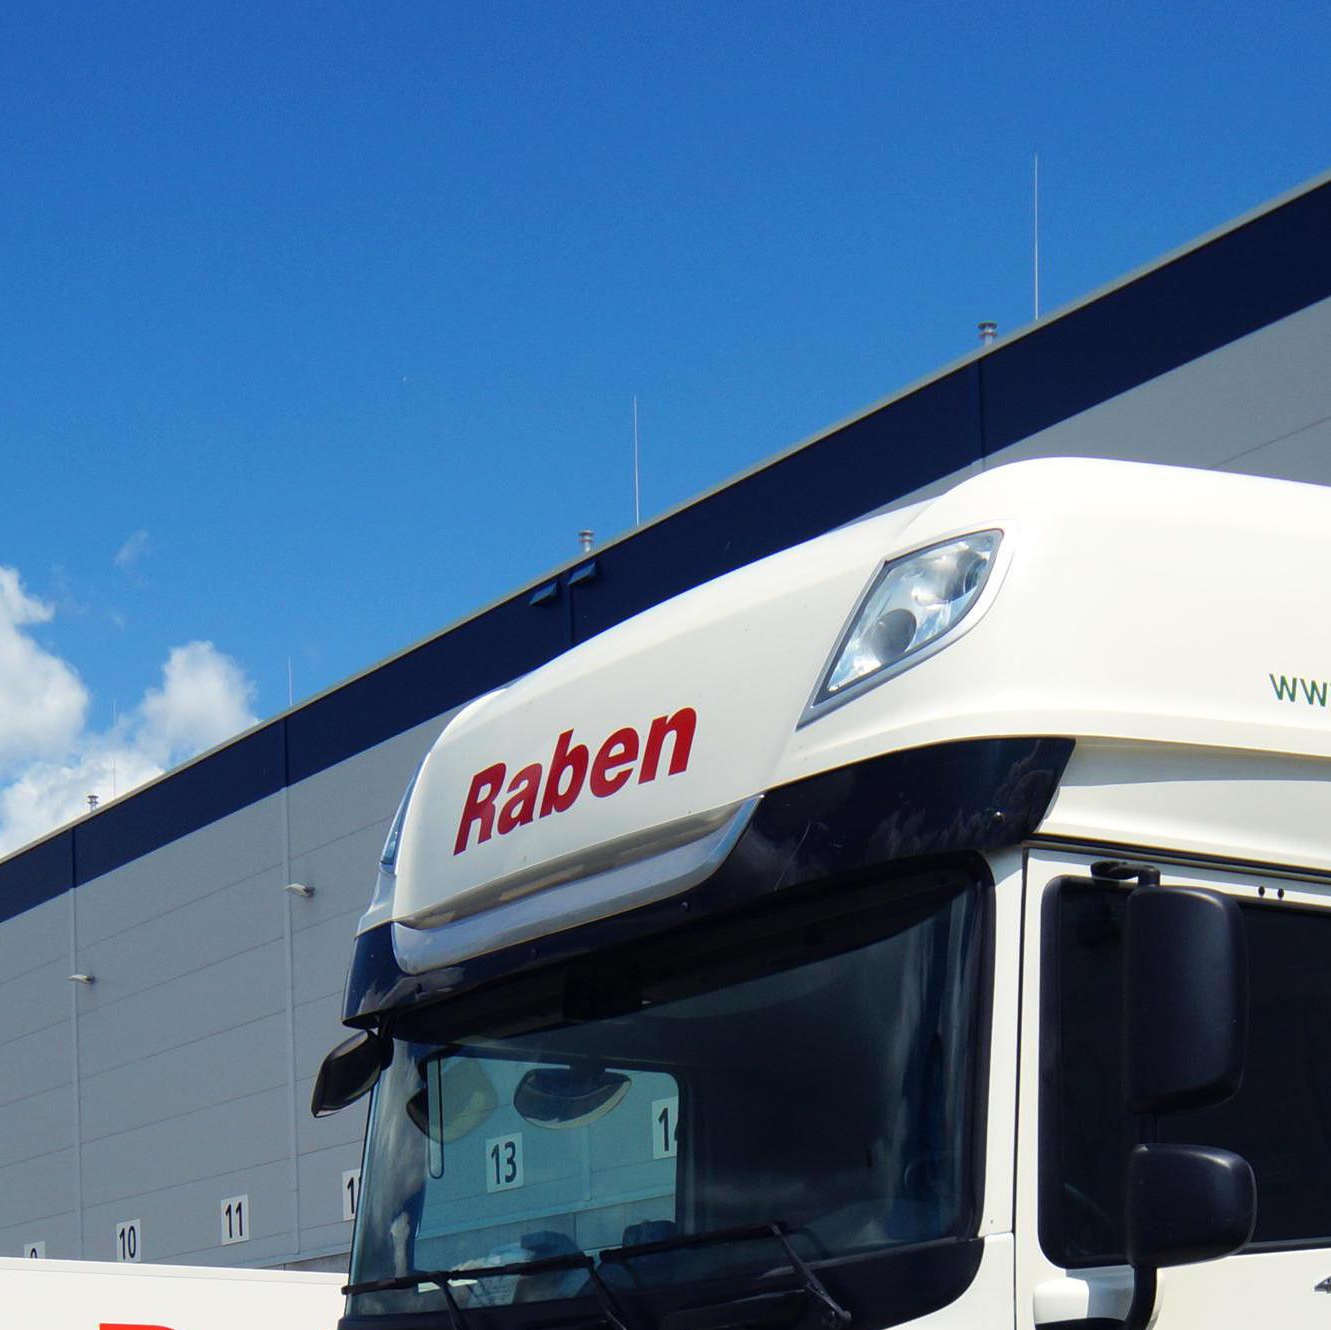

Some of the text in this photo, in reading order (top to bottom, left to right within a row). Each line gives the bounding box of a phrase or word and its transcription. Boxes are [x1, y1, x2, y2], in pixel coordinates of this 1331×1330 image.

[452, 706, 698, 857] Raben
[657, 1106, 678, 1152] 1
[490, 1140, 517, 1185] 13
[224, 1201, 244, 1239] 11
[118, 1225, 137, 1261] 10
